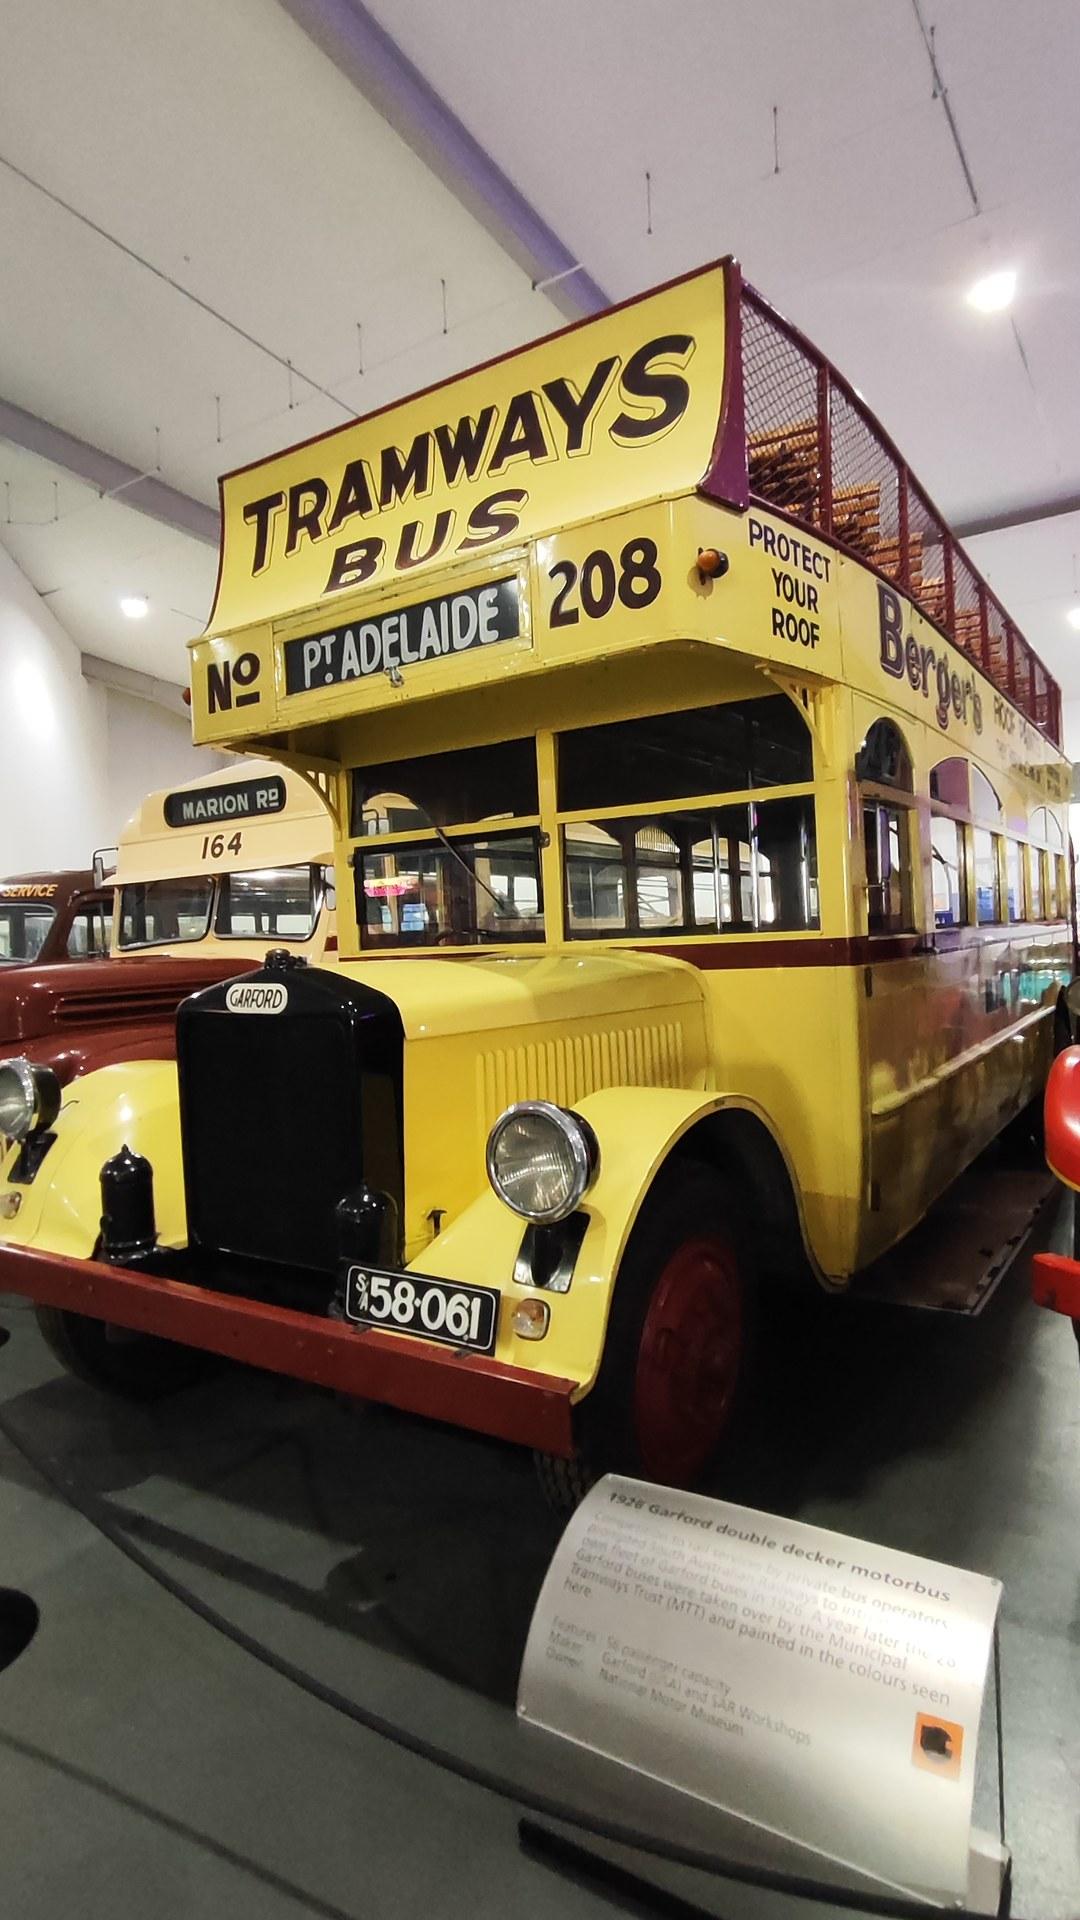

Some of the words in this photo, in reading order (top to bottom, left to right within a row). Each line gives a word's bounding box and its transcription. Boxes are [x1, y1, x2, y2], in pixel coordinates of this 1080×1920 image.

[243, 334, 696, 578] TRAMWAYS
[322, 489, 529, 596] BUS
[748, 518, 831, 583] PROTECT
[549, 537, 662, 628] 208
[771, 567, 819, 614] YOUR
[341, 588, 499, 680] ADELAIDE
[771, 607, 820, 649] ROOF
[182, 793, 249, 820] MARION
[201, 832, 242, 859] 164
[2, 884, 58, 898] SERVICE
[230, 989, 283, 1009] GARFORD
[649, 1504, 713, 1529] Garford
[716, 1524, 776, 1549] double
[782, 1544, 845, 1569] decker
[851, 1565, 951, 1602] motorbus
[576, 1548, 625, 1574] Garford
[700, 1591, 739, 1614] taken
[742, 1606, 774, 1625] over
[777, 1615, 796, 1634] by
[800, 1623, 825, 1642] the
[829, 1632, 908, 1672] Municipal
[822, 1597, 839, 1612] to
[841, 1586, 868, 1605] bus
[634, 1583, 665, 1606] Trust
[666, 1597, 707, 1622] (MTT)
[709, 1613, 737, 1631] and
[738, 1623, 797, 1652] painted
[799, 1644, 814, 1660] in
[819, 1649, 845, 1670] the
[848, 1662, 908, 1692] colours
[911, 1682, 951, 1706] seen
[825, 1616, 860, 1636] year
[863, 1625, 900, 1649] later
[739, 1704, 812, 1747] Workshops
